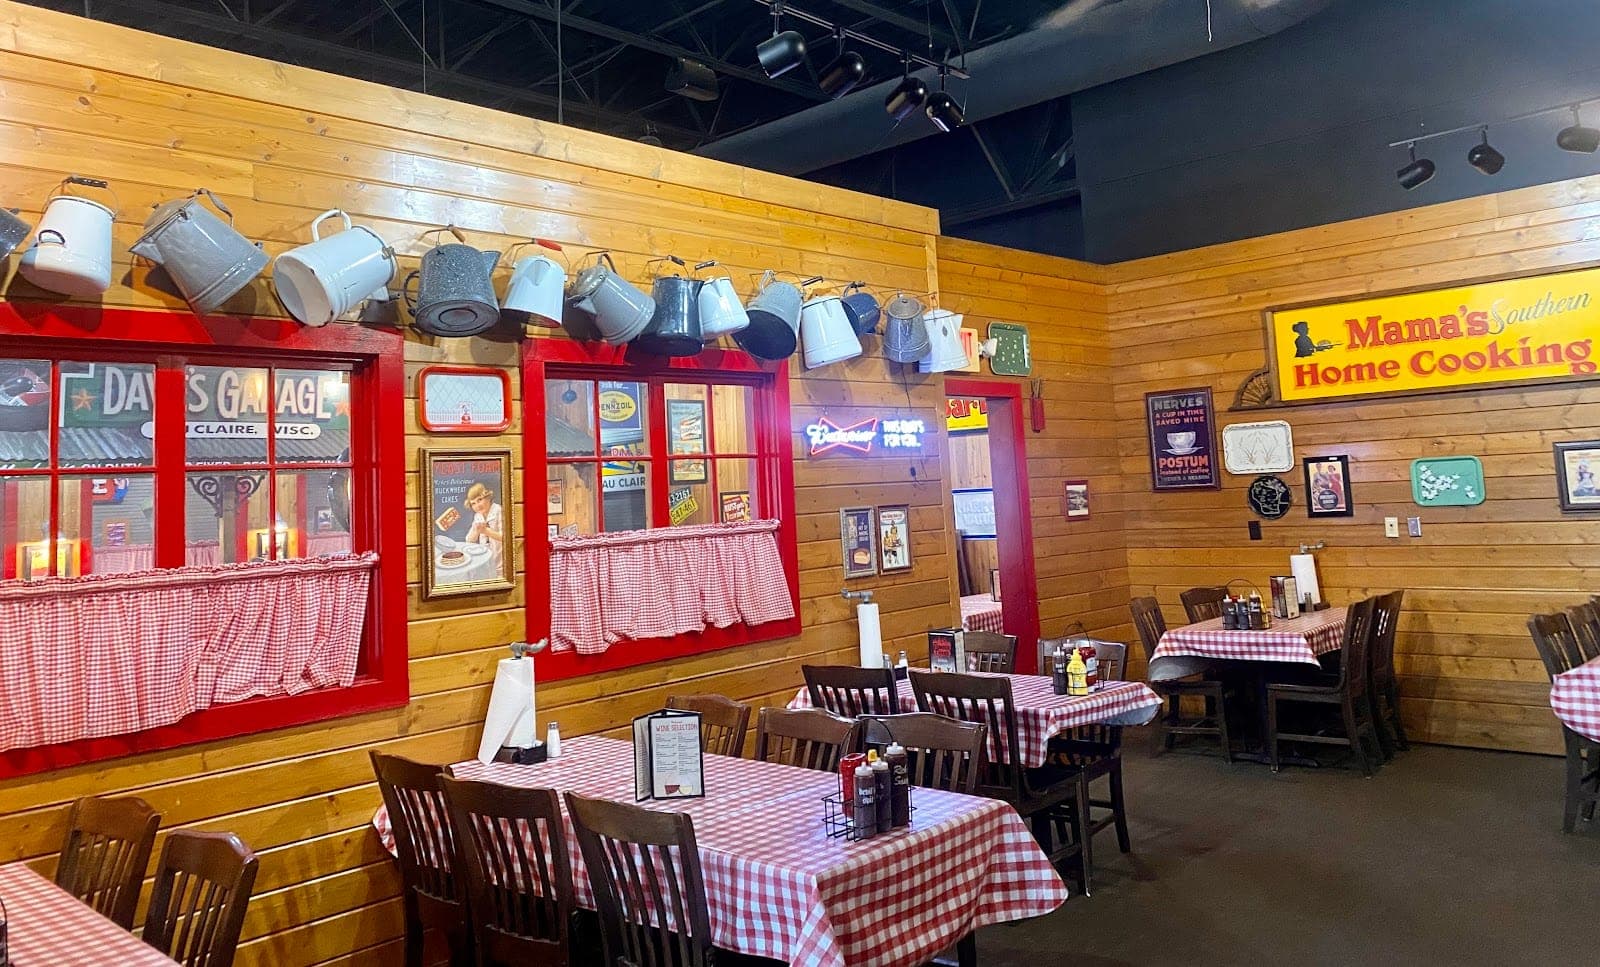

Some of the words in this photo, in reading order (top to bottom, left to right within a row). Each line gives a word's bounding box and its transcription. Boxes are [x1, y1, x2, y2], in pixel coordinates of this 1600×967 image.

[1345, 304, 1490, 350] Mama's
[1488, 291, 1593, 335] Southern
[1294, 359, 1401, 388] Home
[1409, 336, 1597, 376] Cooking
[103, 365, 210, 415] DAV'S
[600, 401, 633, 411] ENNZOIL
[1154, 396, 1204, 411] NERVES
[1187, 408, 1205, 416] TIME
[1155, 417, 1181, 426] SAVED
[1158, 455, 1209, 469] POSTUM
[602, 479, 615, 488] AU
[618, 476, 646, 487] CLAIR
